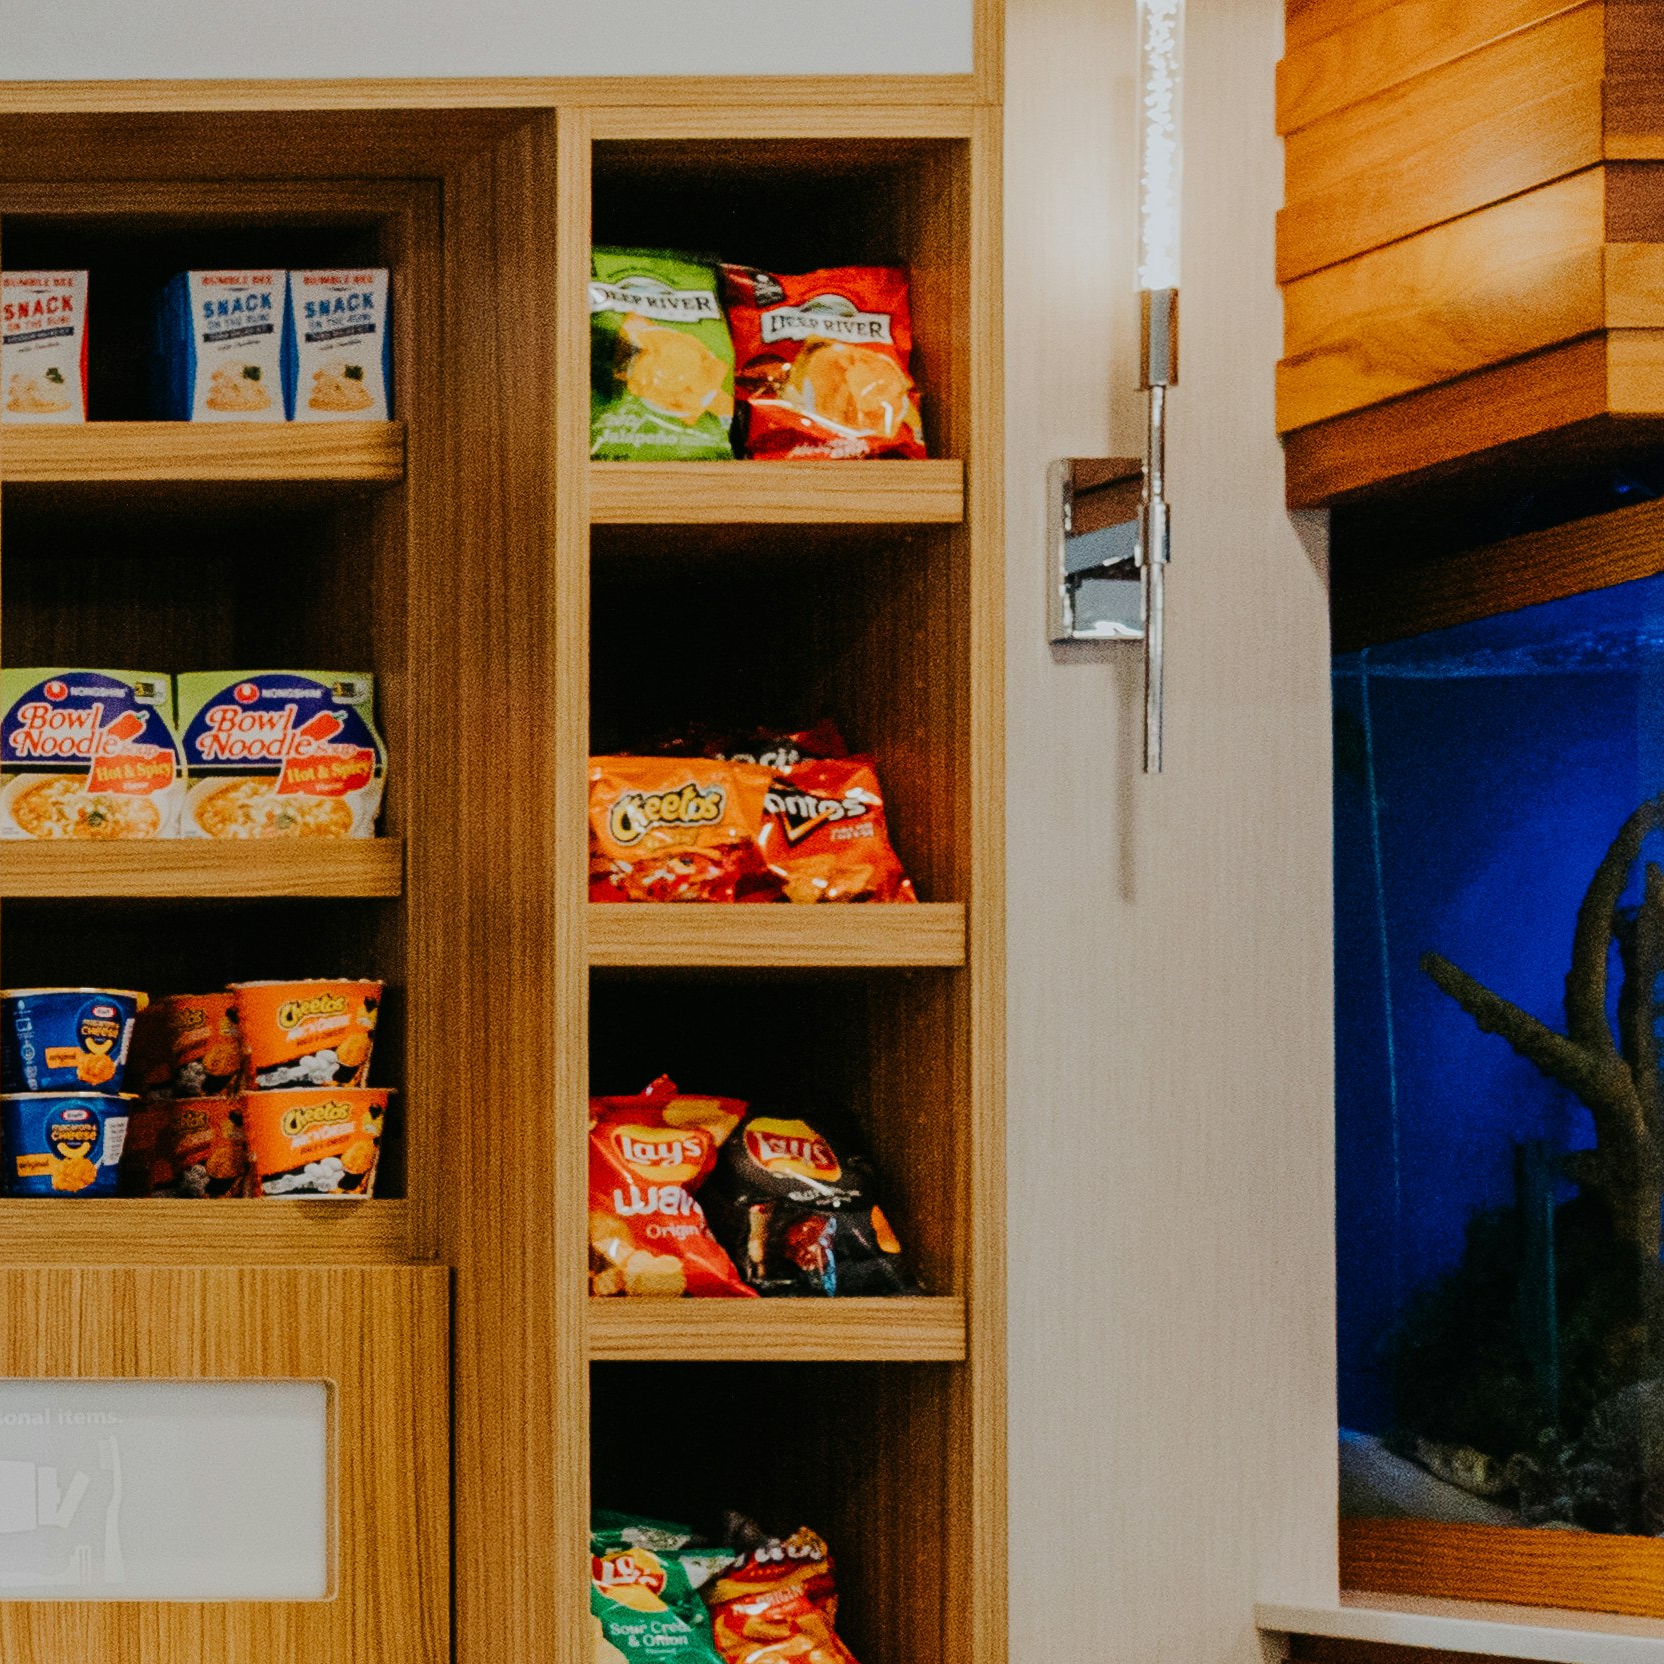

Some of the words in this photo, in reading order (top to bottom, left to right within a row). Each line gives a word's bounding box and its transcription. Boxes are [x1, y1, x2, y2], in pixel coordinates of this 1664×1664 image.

[3, 296, 74, 321] SNACK
[203, 294, 271, 319] SNACK
[304, 293, 374, 319] SNACK
[646, 289, 712, 312] RIVER
[823, 318, 883, 338] RIVER
[20, 704, 103, 731] Bowl
[208, 705, 293, 732] Bowl
[11, 730, 117, 756] Noodle
[197, 731, 312, 759] Noodle
[98, 764, 121, 781] Hot
[136, 759, 171, 782] Spicy
[288, 766, 312, 783] Hot
[329, 759, 371, 782] Spicy
[610, 783, 724, 845] Cheetos
[278, 994, 347, 1029] Cheetos
[283, 1102, 352, 1136] Cheetos
[622, 1133, 702, 1167] Lay's
[57, 1407, 124, 1425] items.
